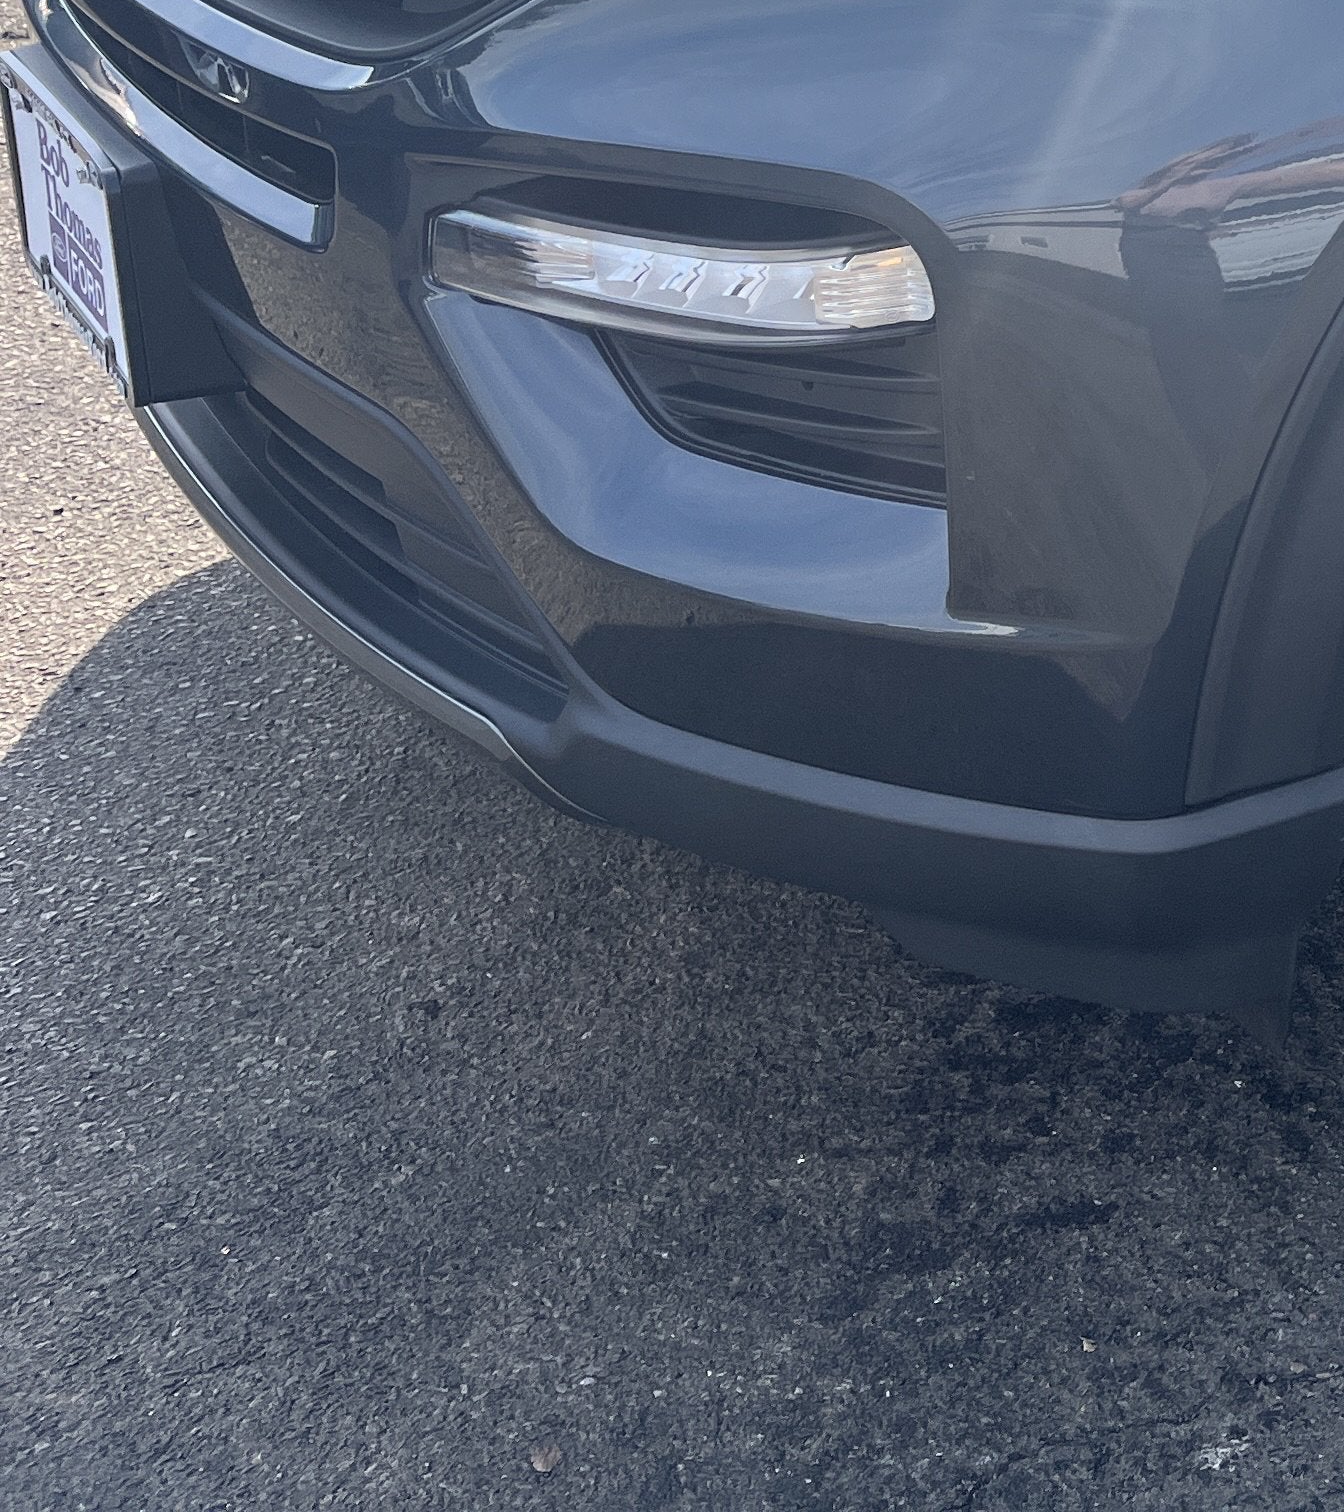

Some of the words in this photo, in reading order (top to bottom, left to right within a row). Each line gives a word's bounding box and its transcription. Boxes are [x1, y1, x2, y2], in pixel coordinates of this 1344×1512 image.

[36, 118, 69, 187] Bob
[41, 164, 103, 270] Thomas
[71, 249, 104, 317] FORD
